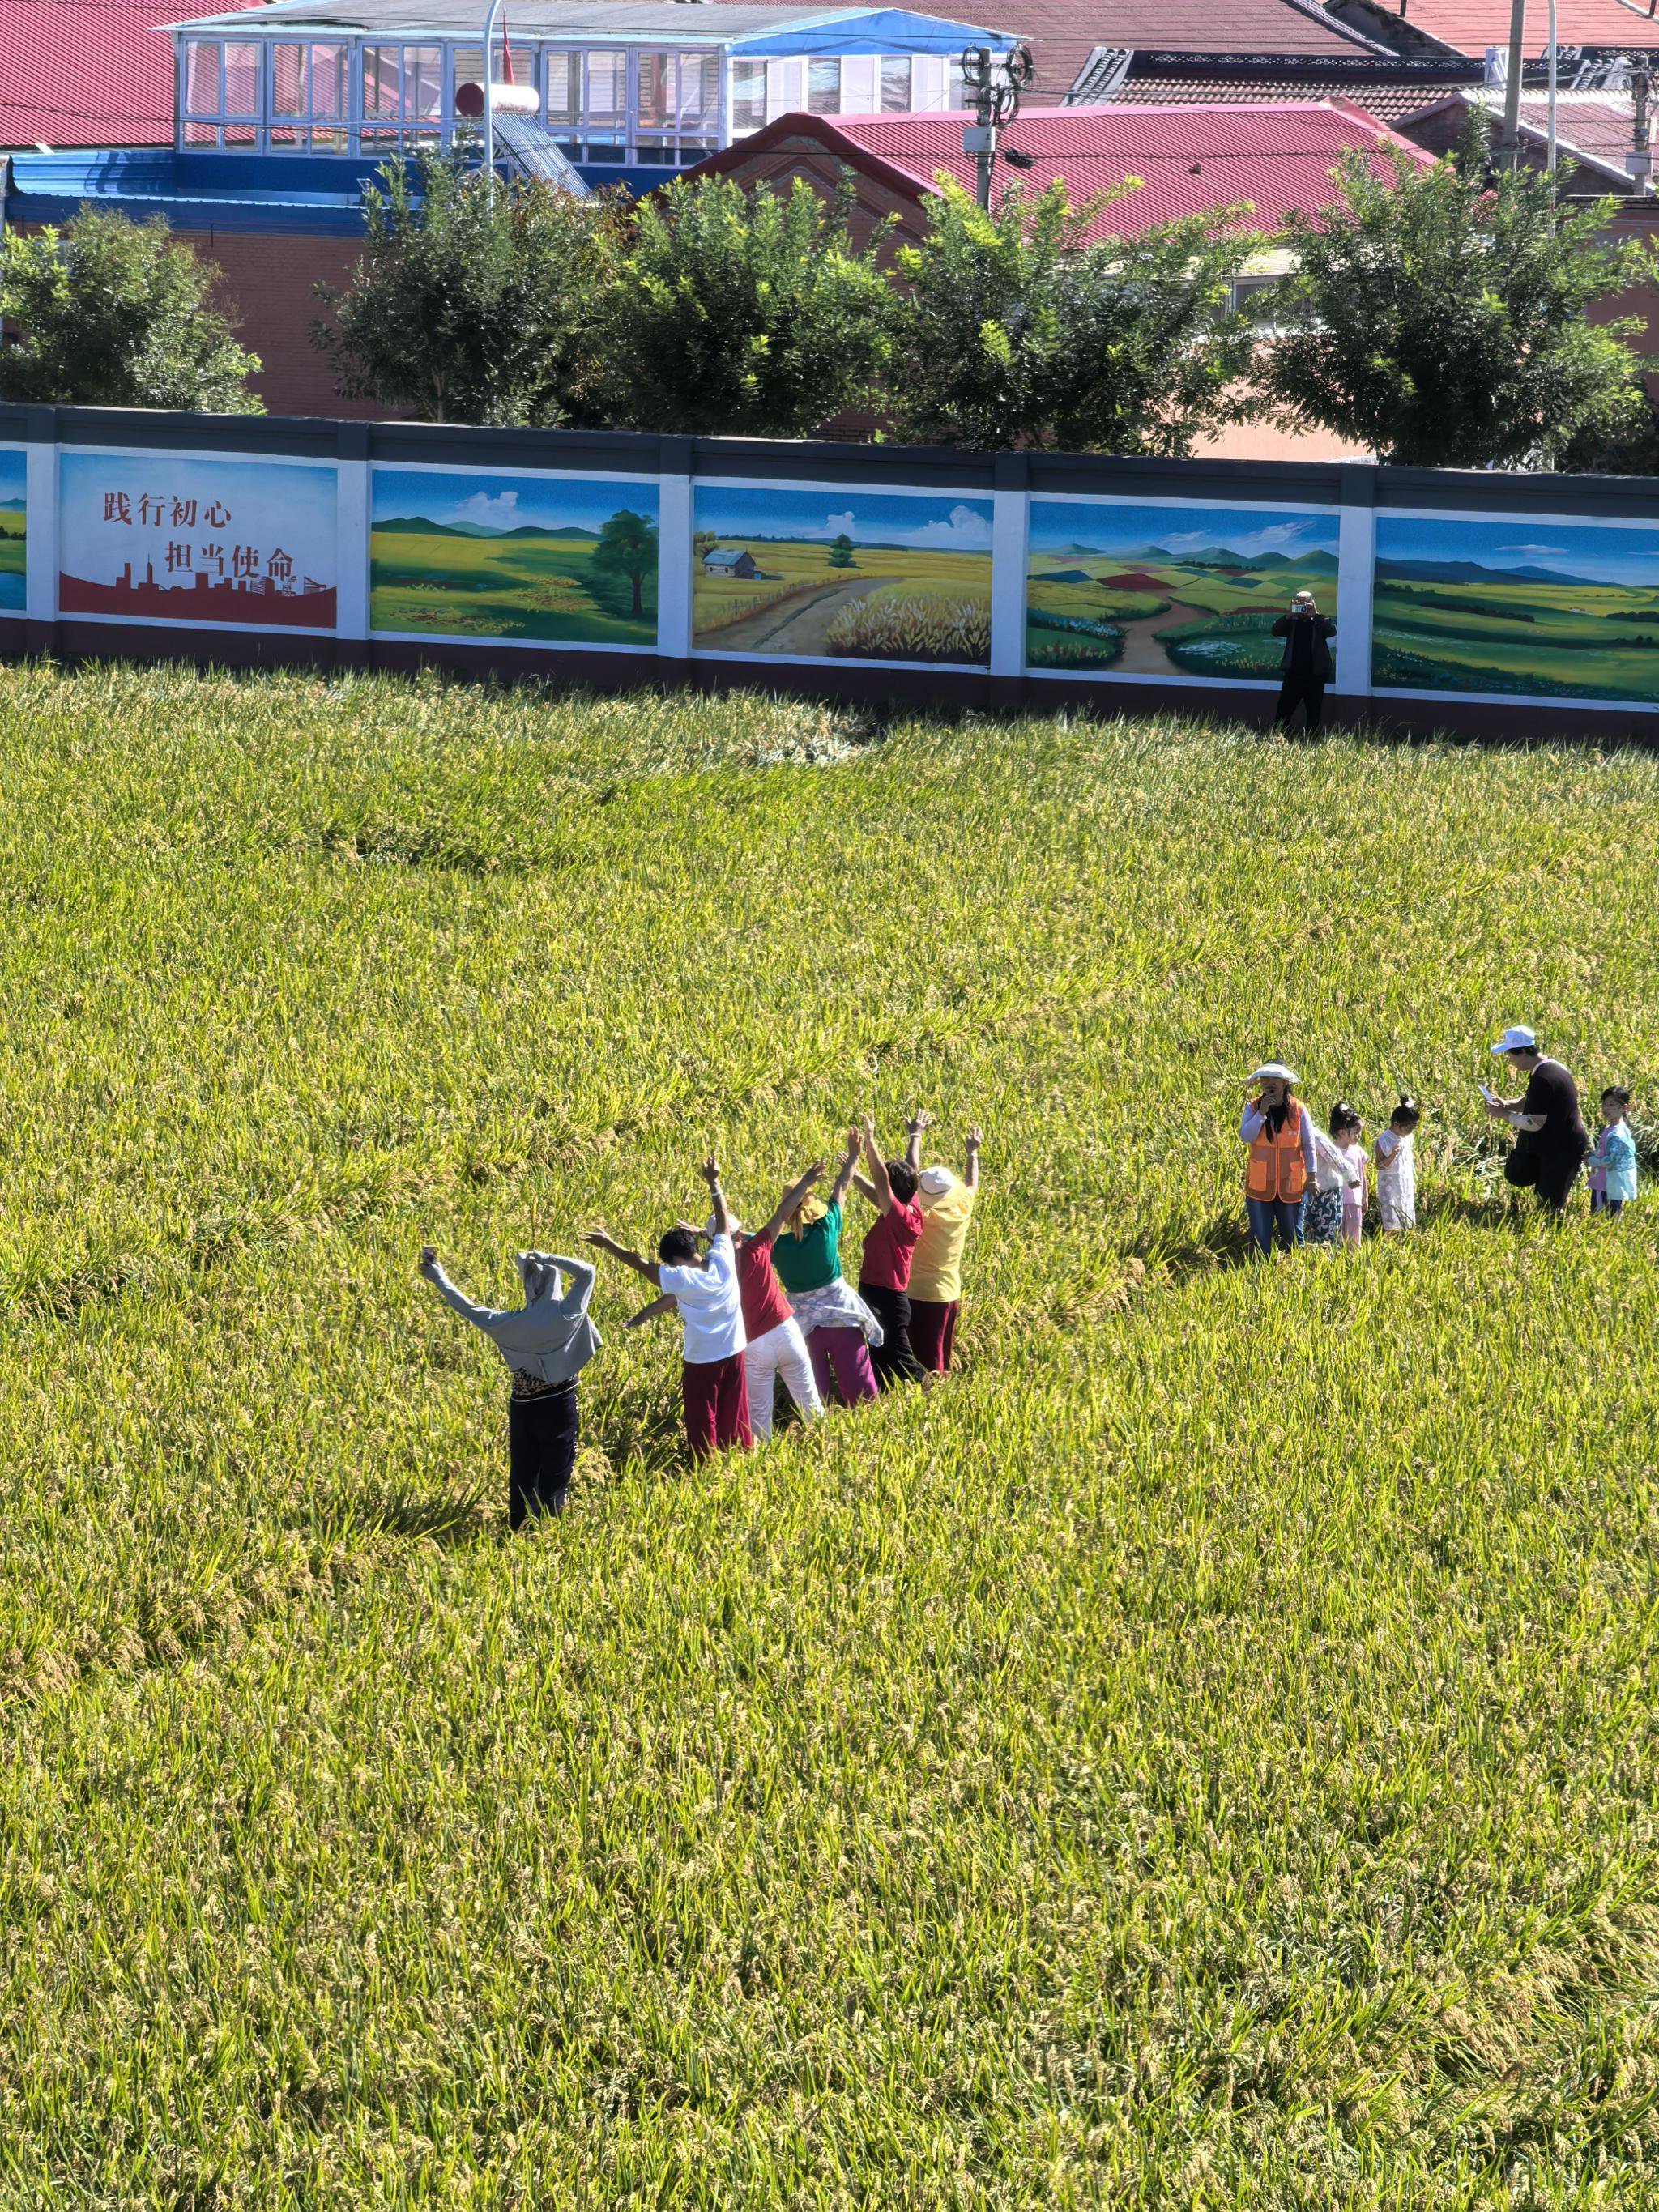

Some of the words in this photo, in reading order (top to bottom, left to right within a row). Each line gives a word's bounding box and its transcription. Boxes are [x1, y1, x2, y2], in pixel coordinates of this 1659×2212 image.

[103, 492, 232, 528] 践行初心
[164, 540, 294, 581] 担当使命
